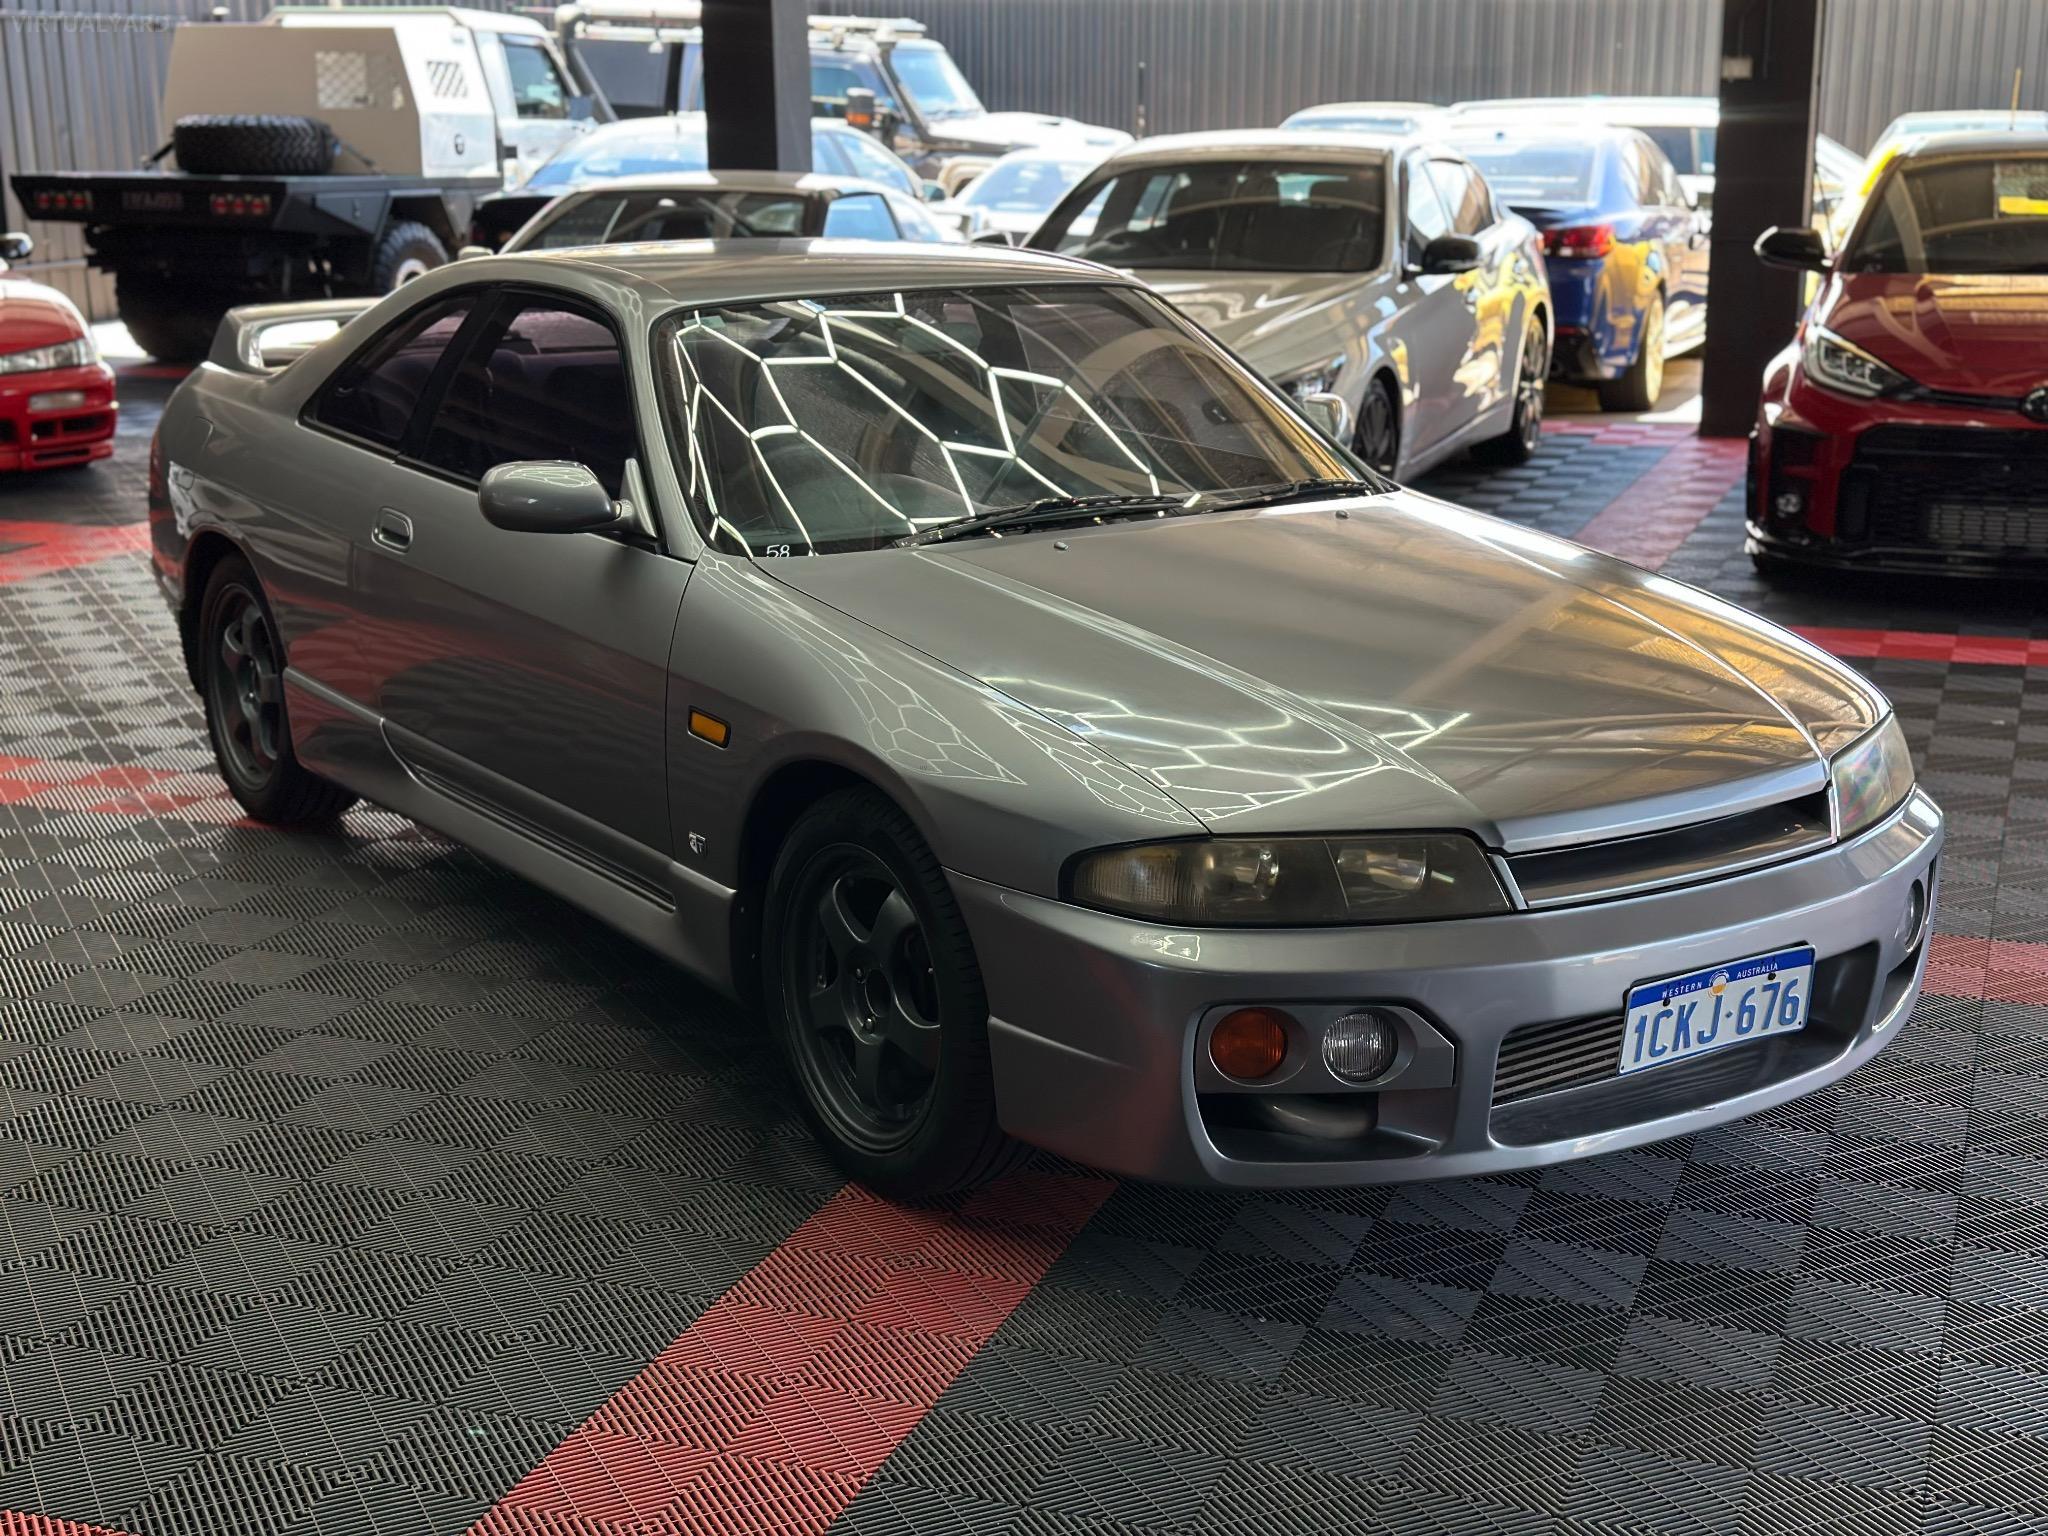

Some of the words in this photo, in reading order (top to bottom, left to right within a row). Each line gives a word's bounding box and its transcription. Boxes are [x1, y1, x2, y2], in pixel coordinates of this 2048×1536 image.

[766, 543, 790, 557] 58
[1662, 982, 1703, 999] WESTERN
[1737, 963, 1779, 979] AUSTRALIA
